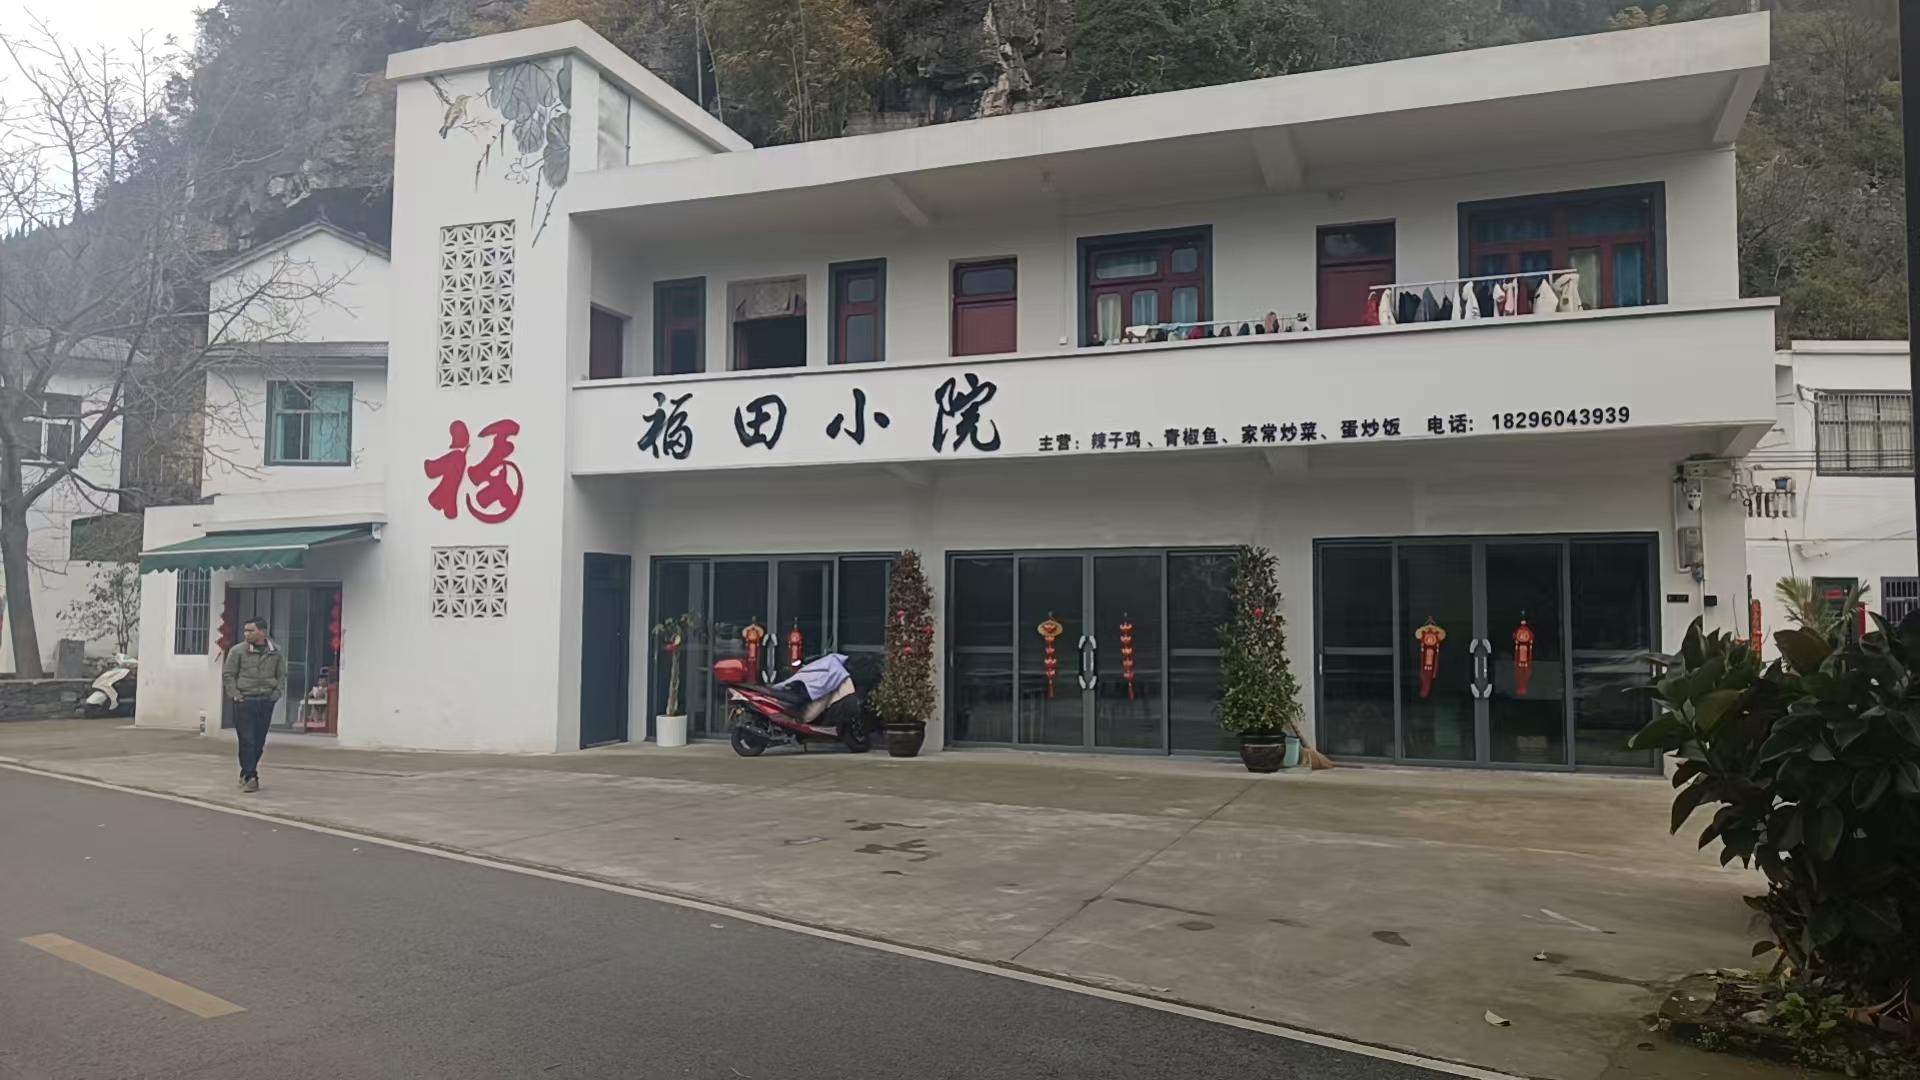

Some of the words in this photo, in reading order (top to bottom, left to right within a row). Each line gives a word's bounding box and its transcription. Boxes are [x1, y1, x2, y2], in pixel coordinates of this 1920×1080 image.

[637, 373, 1001, 459] 福田小院
[1492, 406, 1630, 430] 18296043939
[424, 419, 524, 524] 福
